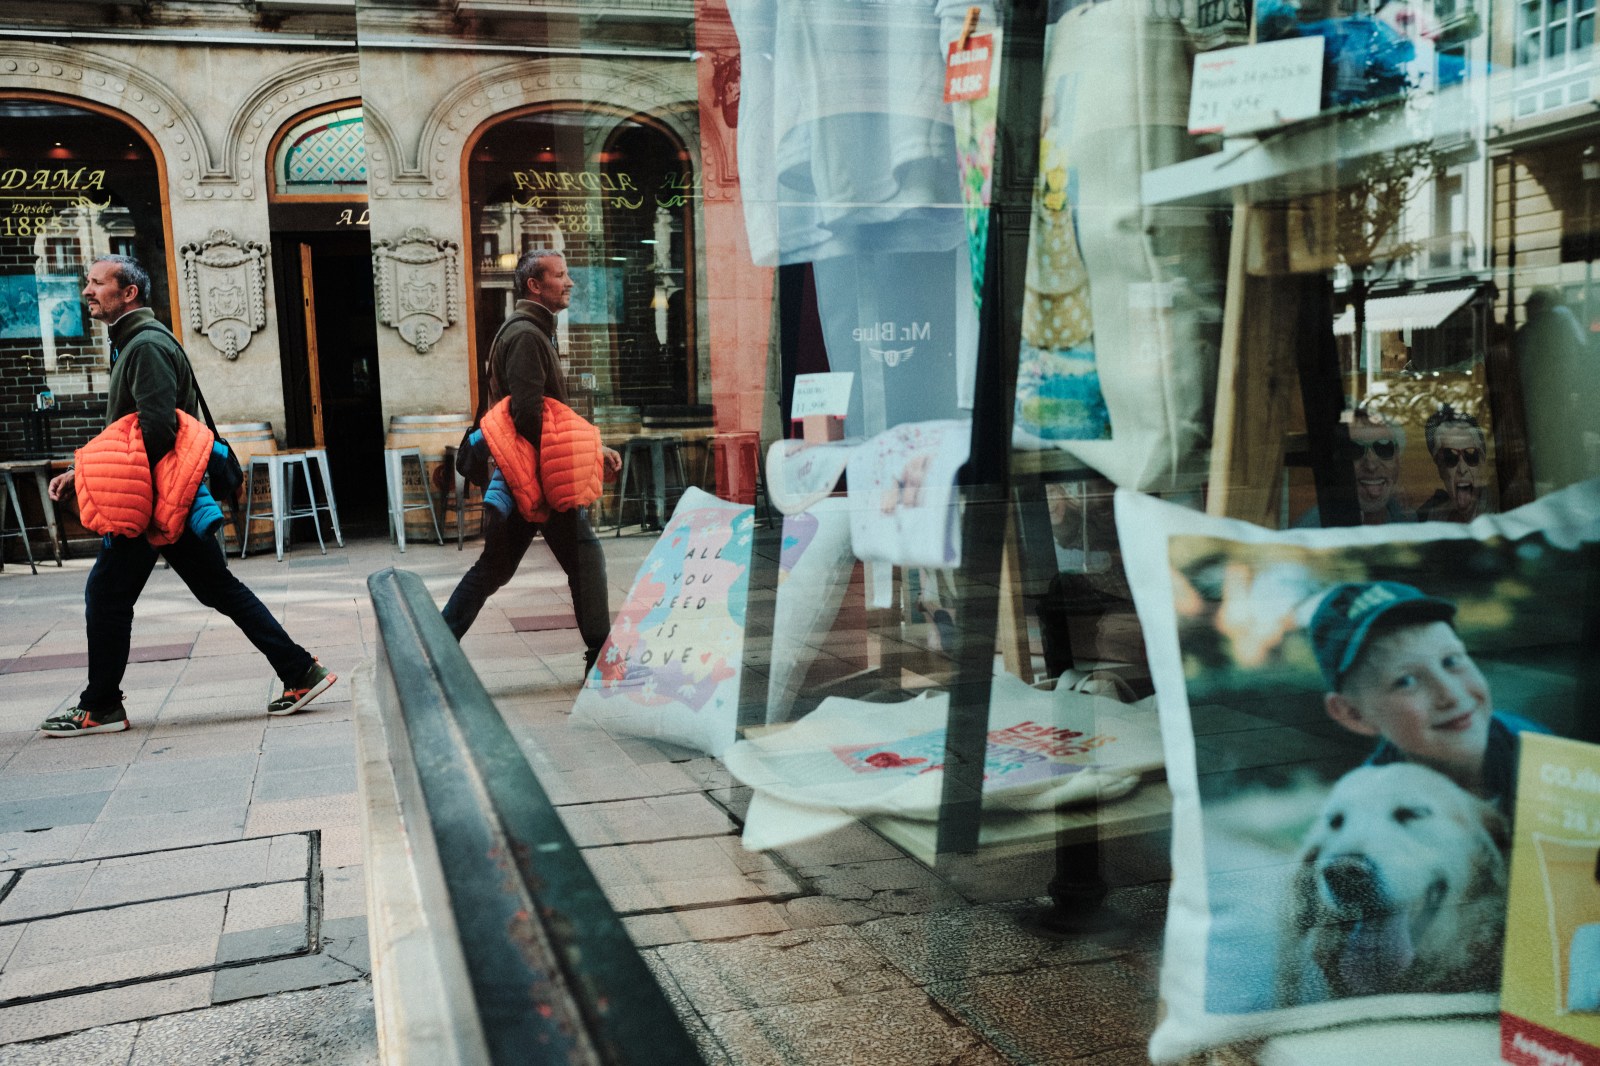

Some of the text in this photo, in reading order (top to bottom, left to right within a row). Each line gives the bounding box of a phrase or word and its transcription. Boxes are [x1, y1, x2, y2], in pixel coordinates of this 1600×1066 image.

[0, 167, 106, 190] DAMA
[12, 202, 53, 214] Desde
[2, 216, 62, 236] 1885
[685, 547, 722, 560] ALL
[673, 573, 713, 586] YOU
[653, 596, 707, 610] NEED
[625, 646, 693, 665] LOVE
